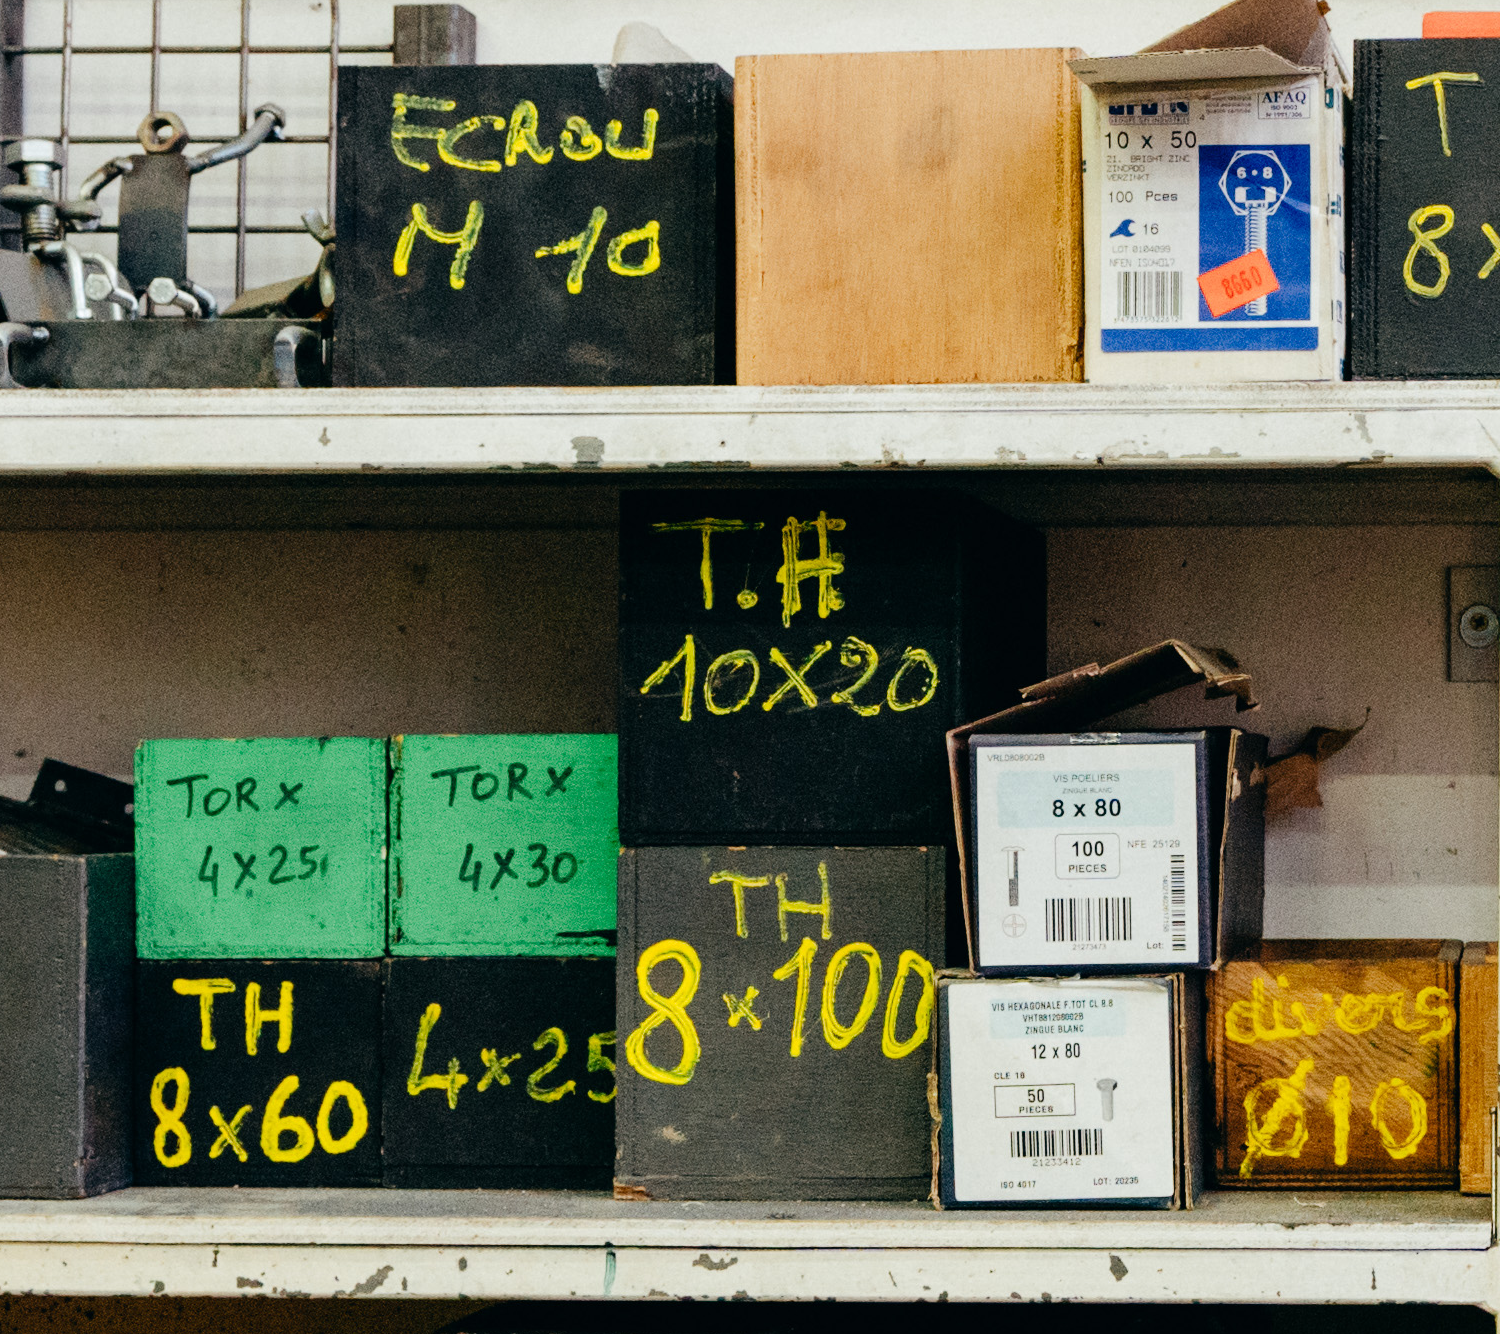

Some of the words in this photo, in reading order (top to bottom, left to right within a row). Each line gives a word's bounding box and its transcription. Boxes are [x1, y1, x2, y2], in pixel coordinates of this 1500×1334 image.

[1104, 131, 1129, 149] 10
[1171, 130, 1197, 149] 50
[1053, 775, 1069, 783] VIS
[1072, 774, 1120, 783] POELIERS
[1052, 799, 1064, 817] 8
[1095, 799, 1121, 817] 80
[1071, 841, 1104, 857] 100
[1068, 864, 1107, 873] PIECES
[992, 1003, 1005, 1011] VIS
[1008, 1001, 1061, 1011] HEXAGONALE
[1058, 1025, 1084, 1033] BLANC
[1032, 1044, 1046, 1059] 12
[1065, 1043, 1081, 1058] 80
[1028, 1089, 1045, 1103] 50
